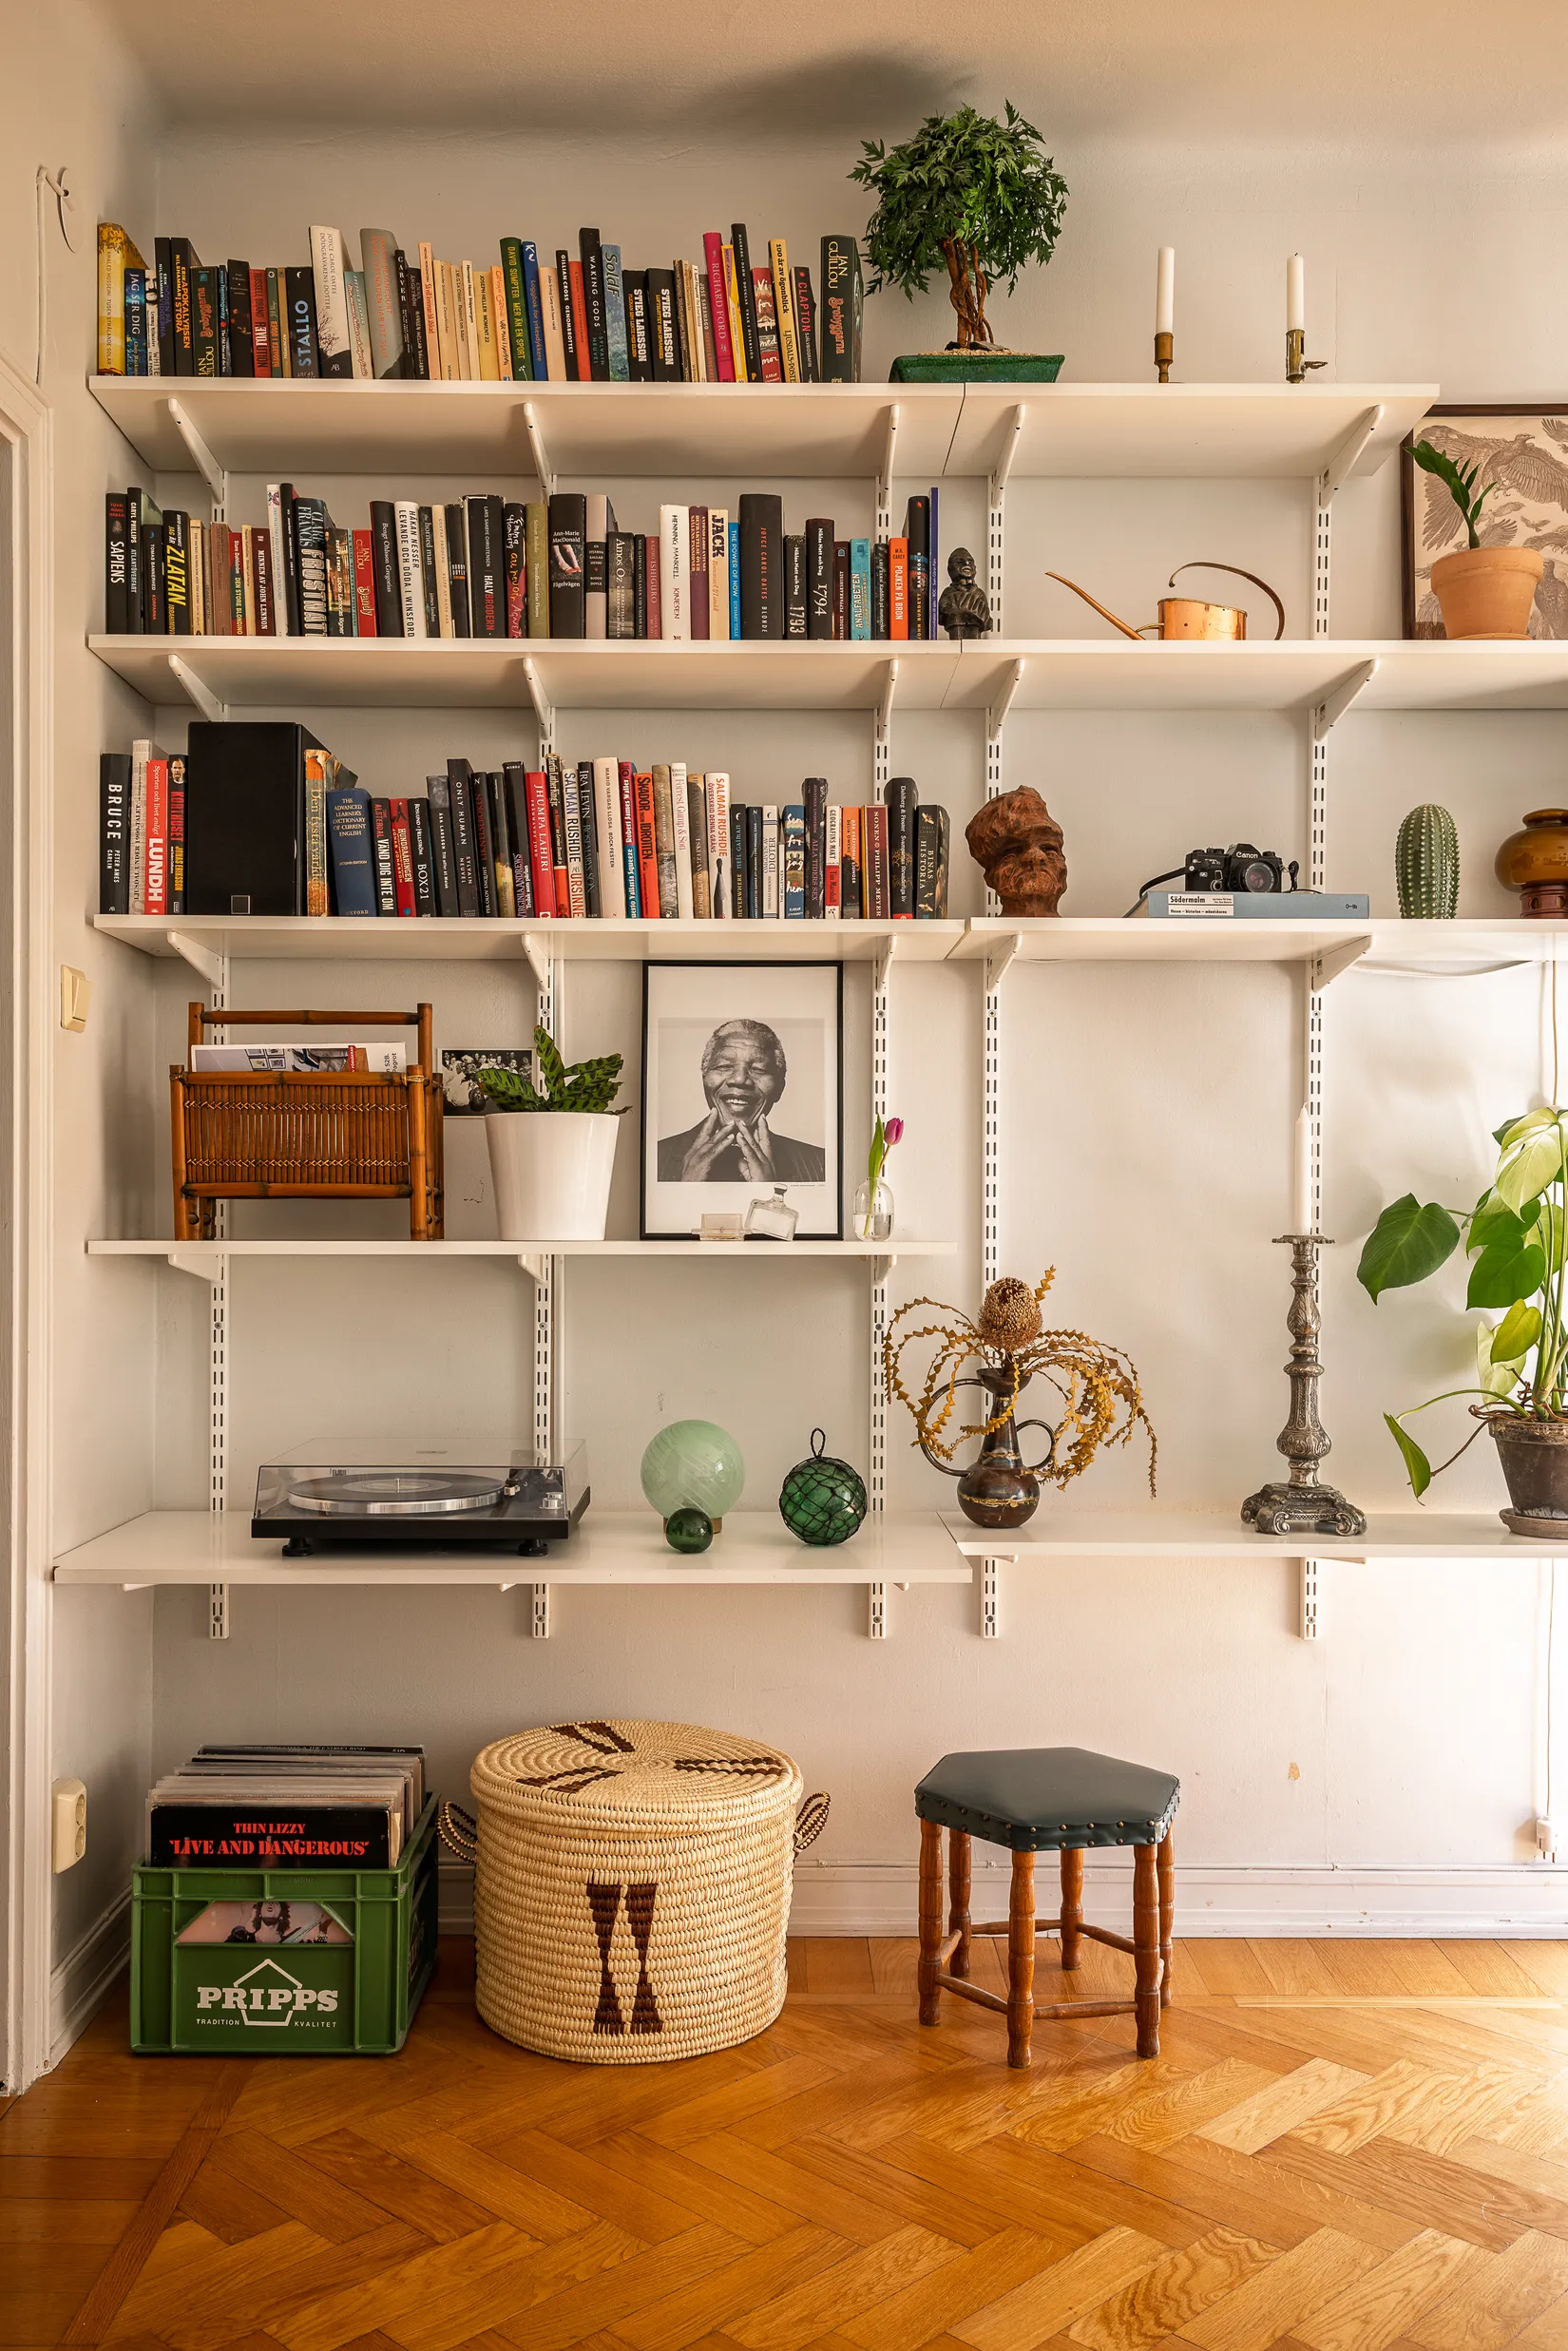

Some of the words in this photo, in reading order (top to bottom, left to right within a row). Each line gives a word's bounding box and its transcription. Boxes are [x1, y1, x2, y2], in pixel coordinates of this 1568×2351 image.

[507, 247, 516, 266] DAVID
[777, 258, 784, 267] år
[828, 241, 839, 289] GUILLOU
[836, 255, 848, 276] JAN
[130, 273, 140, 291] JAG
[510, 268, 520, 298] SUMPTER
[590, 256, 598, 295] WAKING
[605, 252, 620, 298] SoldF
[711, 262, 723, 307] RICHARD
[778, 267, 784, 275] av
[131, 295, 140, 311] SER
[513, 302, 521, 316] MER
[634, 289, 644, 317] STIEG
[661, 289, 671, 318] STIEG
[779, 277, 789, 314] ögonblick
[798, 282, 811, 332] CLAPTON
[132, 315, 141, 335] DIG
[181, 281, 191, 349] APOKALYPSEN
[515, 317, 524, 327] ÄN
[565, 305, 574, 353] GENOMBROTTET
[716, 310, 727, 339] FORD
[828, 297, 845, 354] Brobyggarna
[255, 322, 268, 368] REVOLUTION
[295, 300, 312, 366] STALLO
[516, 329, 523, 338] EN
[636, 318, 647, 362] LARSSON
[663, 320, 674, 365] LARSSON
[516, 338, 526, 359] SPORT
[381, 522, 389, 539] Bengt
[399, 510, 410, 544] LEVANDE
[409, 510, 419, 535] HÅKAN
[711, 514, 725, 558] JACK
[110, 541, 125, 583] SAPIENS
[258, 550, 266, 575] MINNEN
[383, 540, 391, 564] Ohlsson
[402, 547, 410, 563] OCH
[411, 538, 420, 569] NESSER
[615, 538, 625, 566] Amos
[166, 545, 186, 606] ZLATAN
[259, 575, 266, 584] AV
[384, 564, 392, 592] Gregorius
[403, 566, 413, 587] DÖDA
[616, 568, 625, 583] Oz
[732, 569, 738, 579] OF
[895, 565, 903, 591] POJKEN
[357, 586, 375, 616] Dandy
[484, 575, 495, 631] HALVBRODERN
[813, 583, 828, 616] 1794
[852, 573, 863, 628] ANALFABETEN
[895, 592, 904, 601] PÅ
[404, 596, 415, 638] WINSFORD
[789, 606, 805, 633] 1793
[895, 602, 904, 620] BRON
[152, 765, 160, 790] Sporten
[675, 779, 685, 804] Forrest
[456, 782, 464, 806] ONLY
[534, 784, 546, 829] JHUMPA
[564, 773, 578, 815] SALMAN
[637, 776, 652, 812] SKADOR
[708, 783, 716, 813] ÖVERSKRID
[716, 778, 727, 816] SALMAN
[107, 784, 122, 840] BRUCE
[152, 817, 160, 835] enligt
[675, 805, 687, 828] Gump
[458, 811, 467, 845] HUMAN
[567, 818, 581, 863] RUSHDIE
[640, 822, 653, 860] IDROTTEN
[717, 818, 728, 857] RUSHDIE
[377, 839, 391, 860] VÄND
[397, 828, 413, 882] HUNDRAÅRINGEN
[538, 833, 549, 872] LAHIRI
[679, 836, 688, 851] Son
[148, 838, 163, 901] LUNDH
[379, 861, 392, 876] DIG
[417, 863, 428, 885] BOX
[380, 878, 392, 896] INTE
[419, 887, 430, 900] 21
[570, 873, 584, 917] URSINNE
[382, 898, 394, 910] OM
[234, 1823, 267, 1834] THIN
[269, 1823, 306, 1834] LIZZY
[217, 1840, 255, 1854] AND
[197, 1986, 338, 2012] PRIPPS
